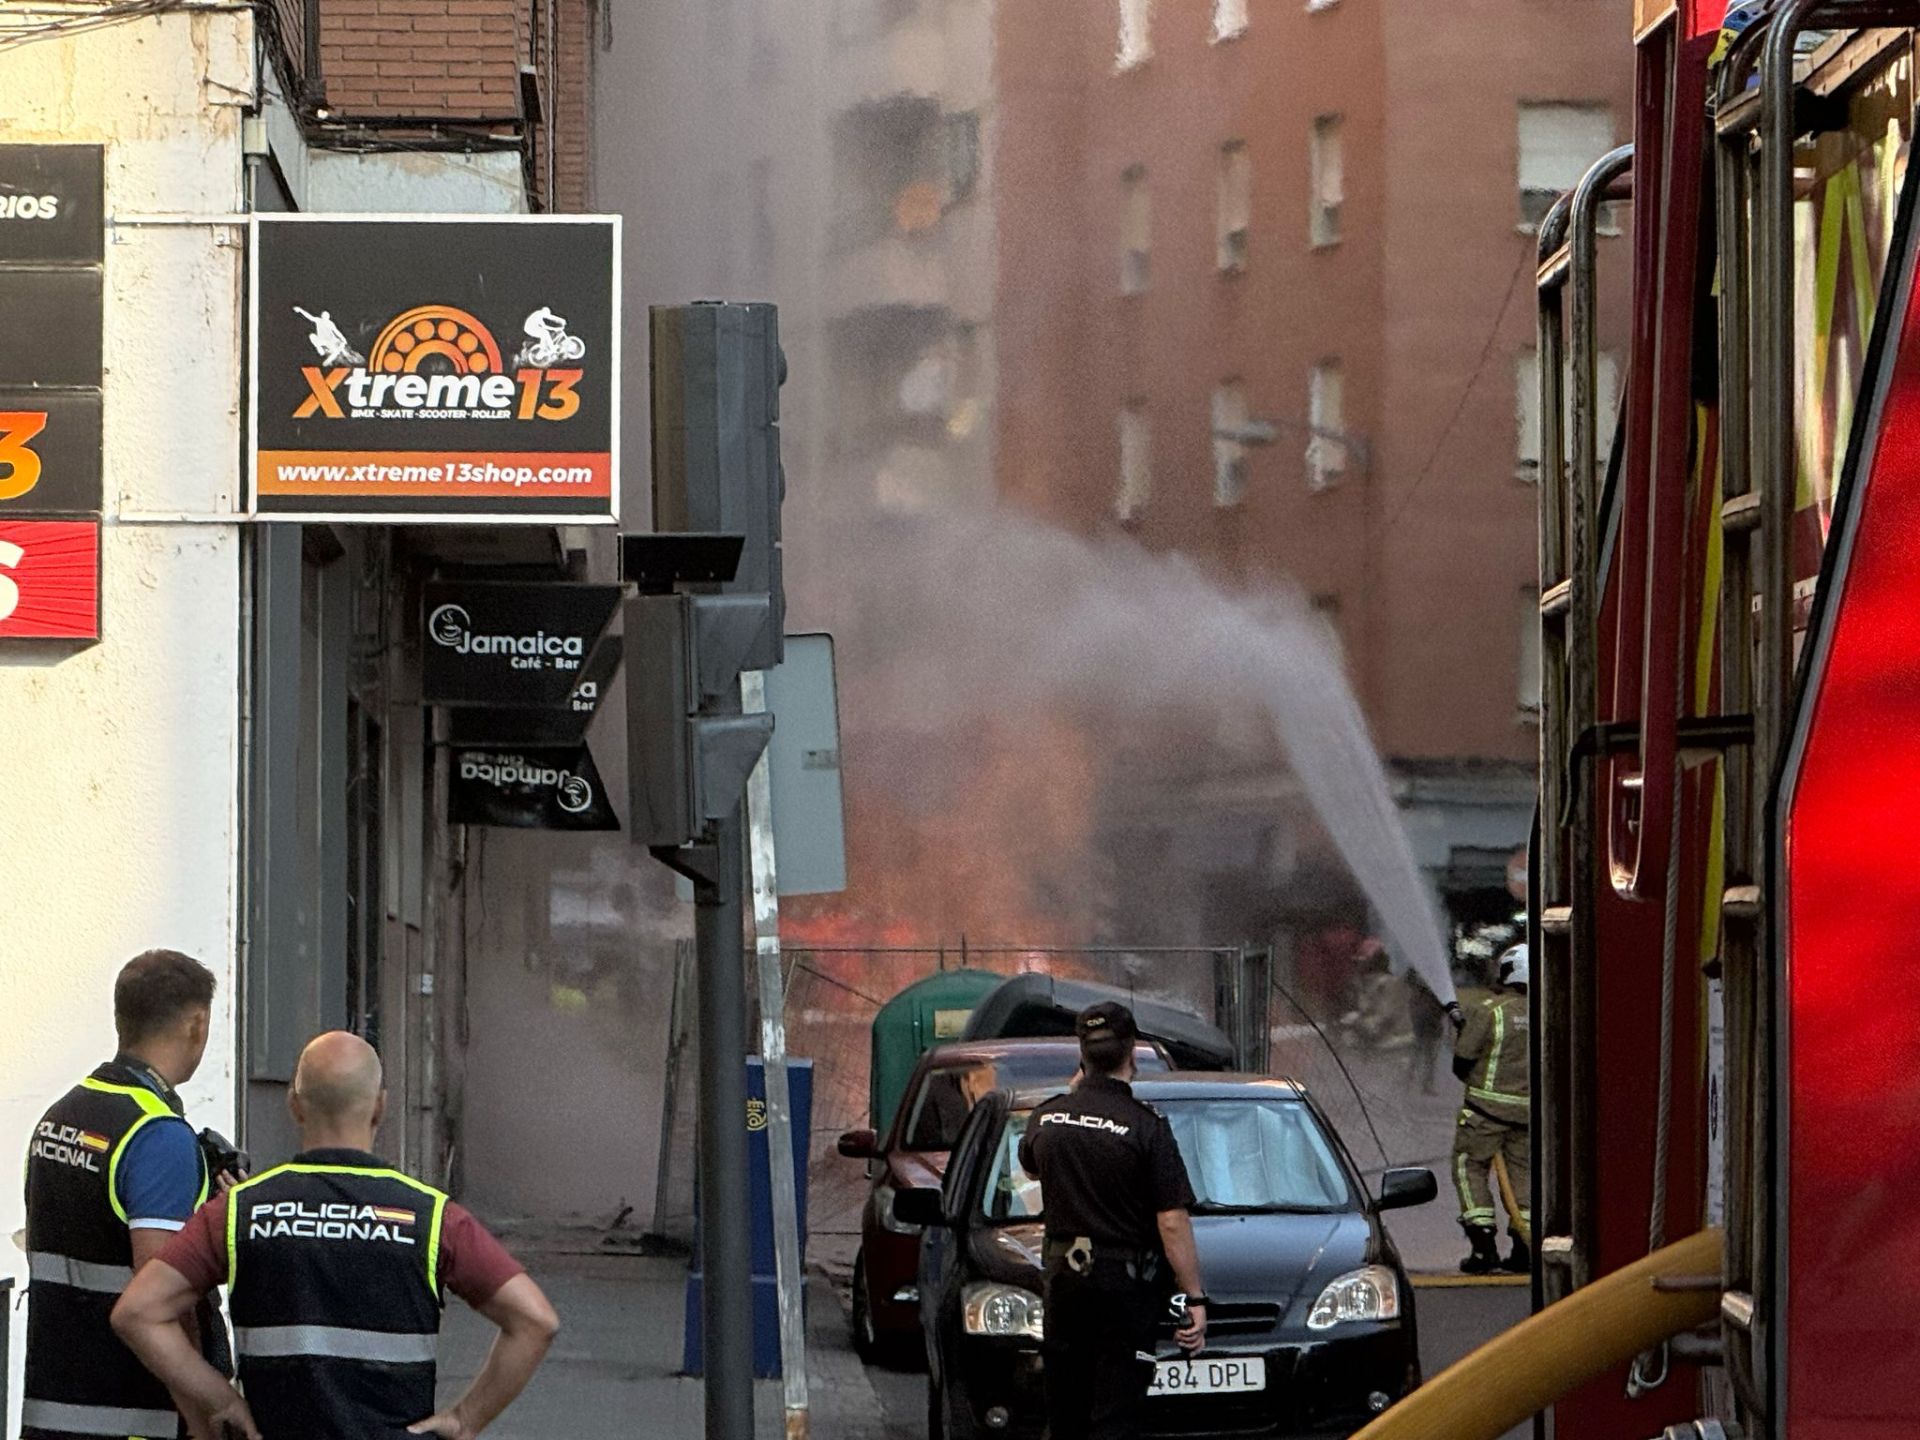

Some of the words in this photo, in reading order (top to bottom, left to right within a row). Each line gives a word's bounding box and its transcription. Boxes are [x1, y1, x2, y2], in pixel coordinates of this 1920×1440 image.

[277, 463, 593, 487] www.xtreme13shop.com
[456, 630, 583, 656] Jamaica
[511, 656, 541, 669] Café
[555, 657, 579, 669] Bar
[461, 762, 570, 790] Jamaica
[250, 1201, 378, 1221] POLICIA
[249, 1220, 416, 1246] NACIONAL
[1208, 1362, 1258, 1388] DPL
